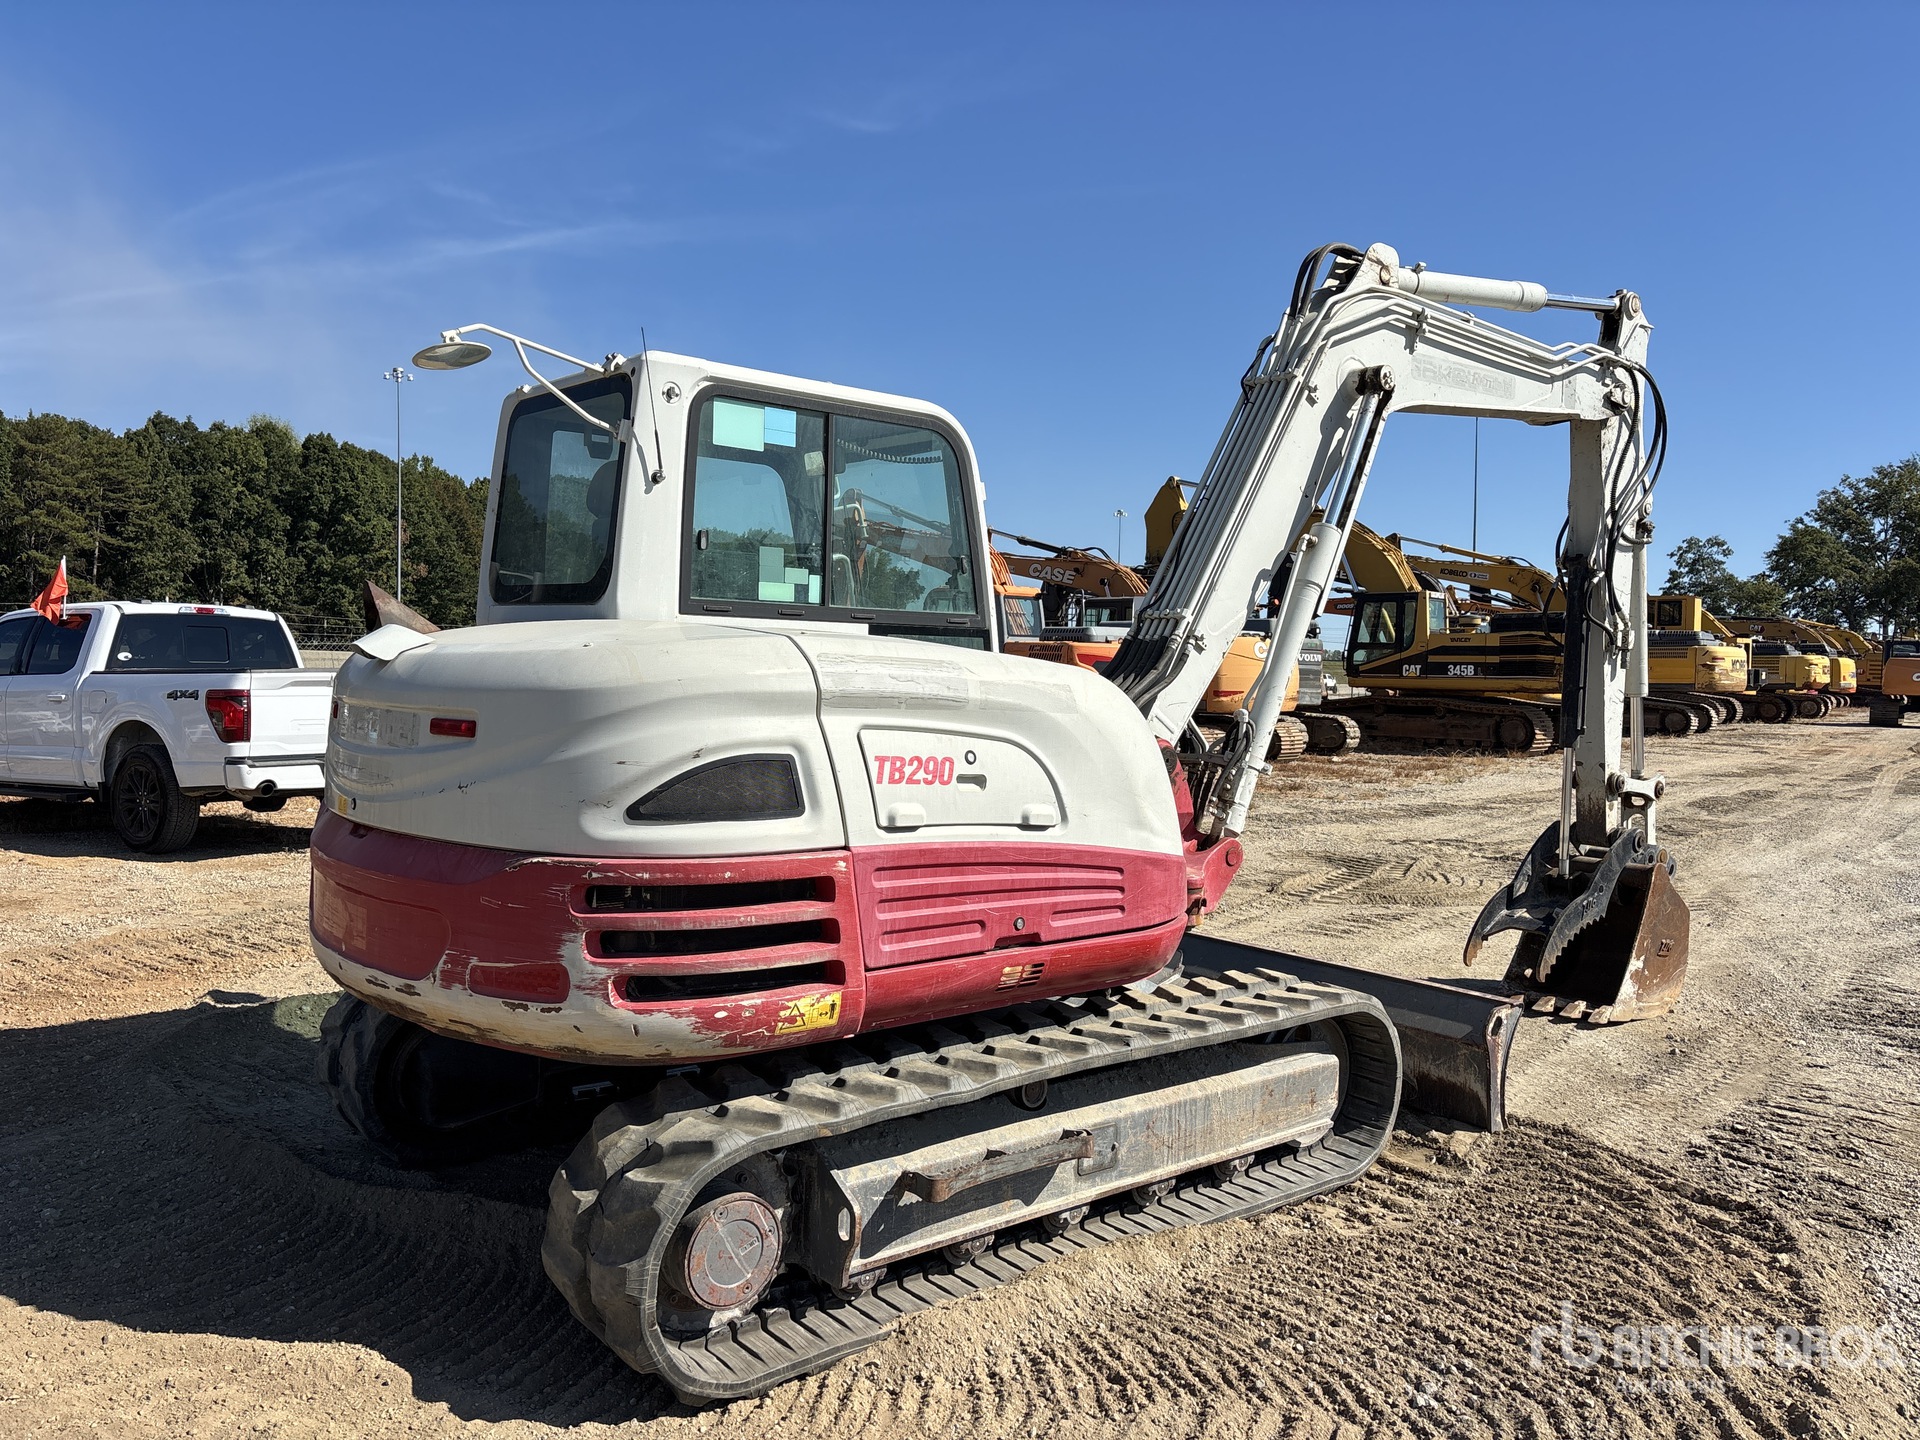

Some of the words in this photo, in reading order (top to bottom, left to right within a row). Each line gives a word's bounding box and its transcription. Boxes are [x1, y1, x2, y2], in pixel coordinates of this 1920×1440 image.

[1028, 563, 1077, 585] CASE
[1439, 568, 1468, 578] KOBELCO
[1749, 624, 1762, 632] CAT
[1402, 664, 1422, 677] CAT
[1447, 664, 1475, 676] 345B
[166, 689, 200, 701] 4X4
[873, 755, 955, 786] TB290
